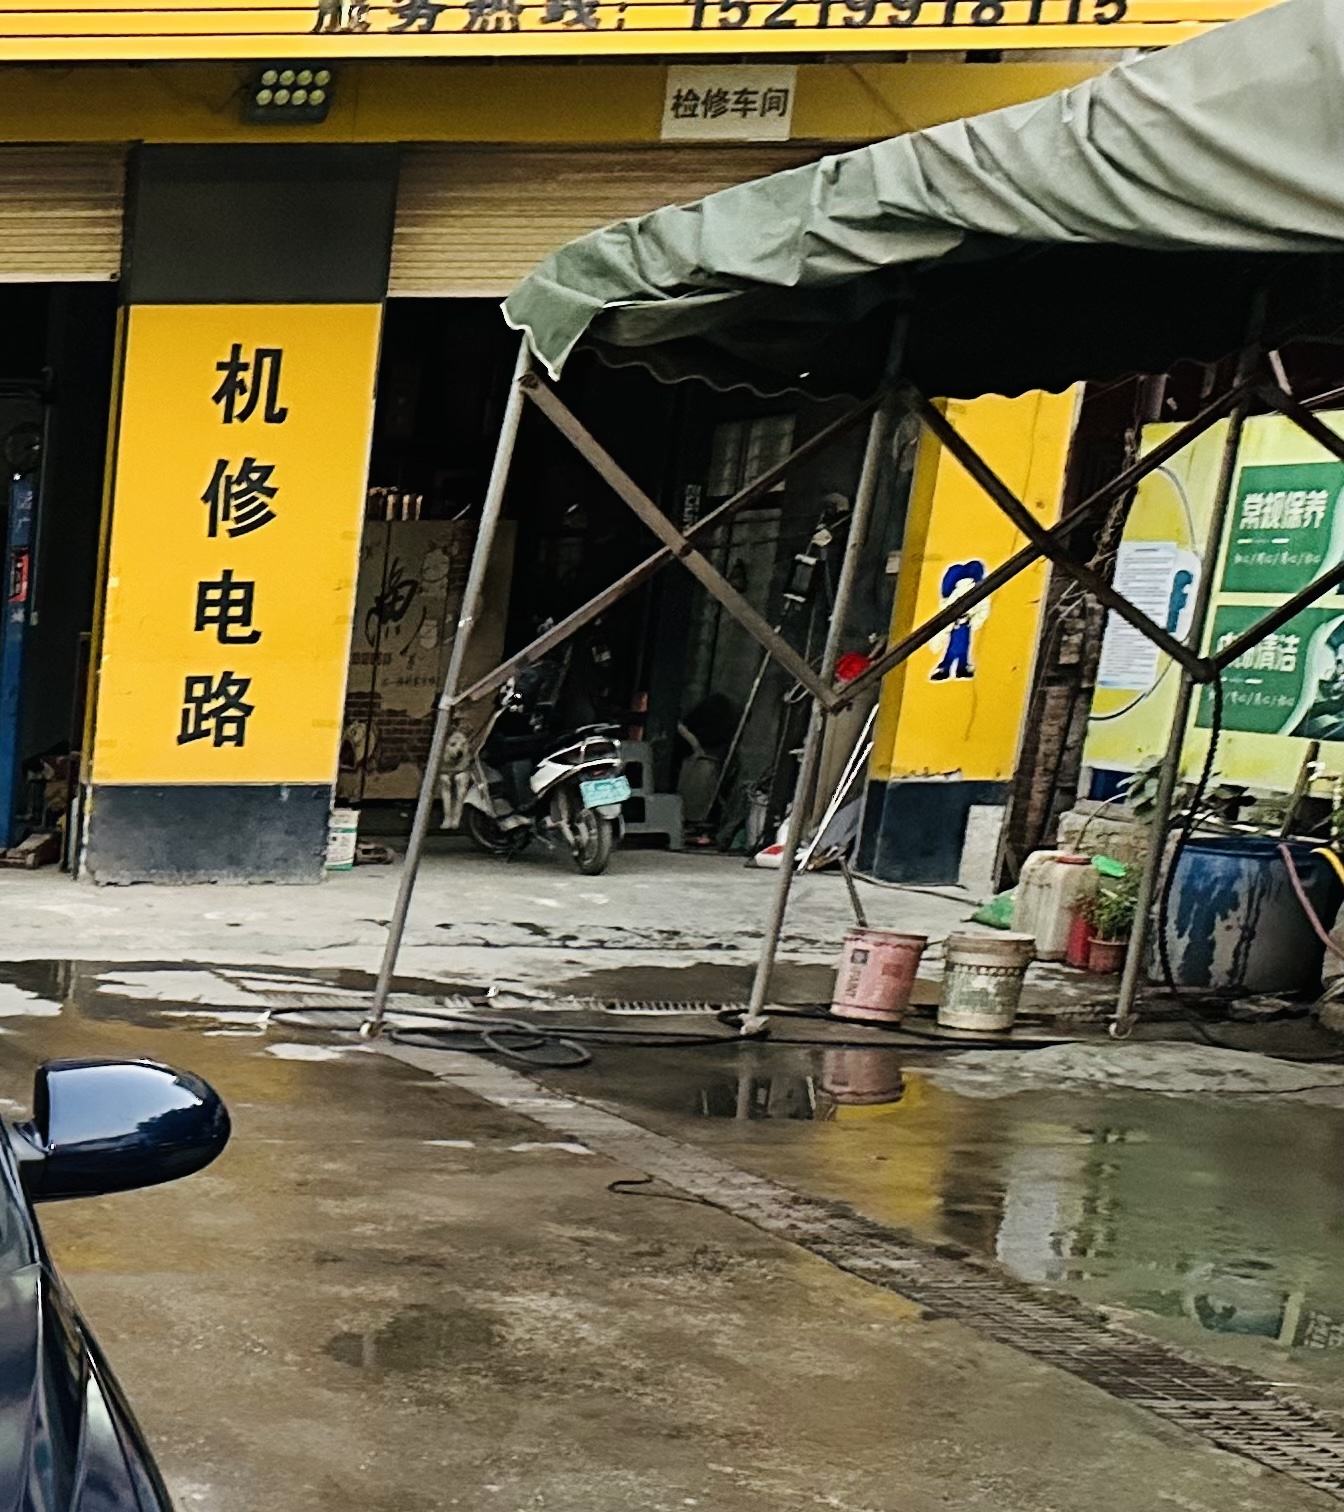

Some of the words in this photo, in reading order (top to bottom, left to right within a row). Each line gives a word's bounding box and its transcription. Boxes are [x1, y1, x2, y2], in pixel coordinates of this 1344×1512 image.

[670, 87, 789, 120] 检修车间
[1239, 489, 1329, 530] 常规保养
[176, 342, 289, 748] 机修电路
